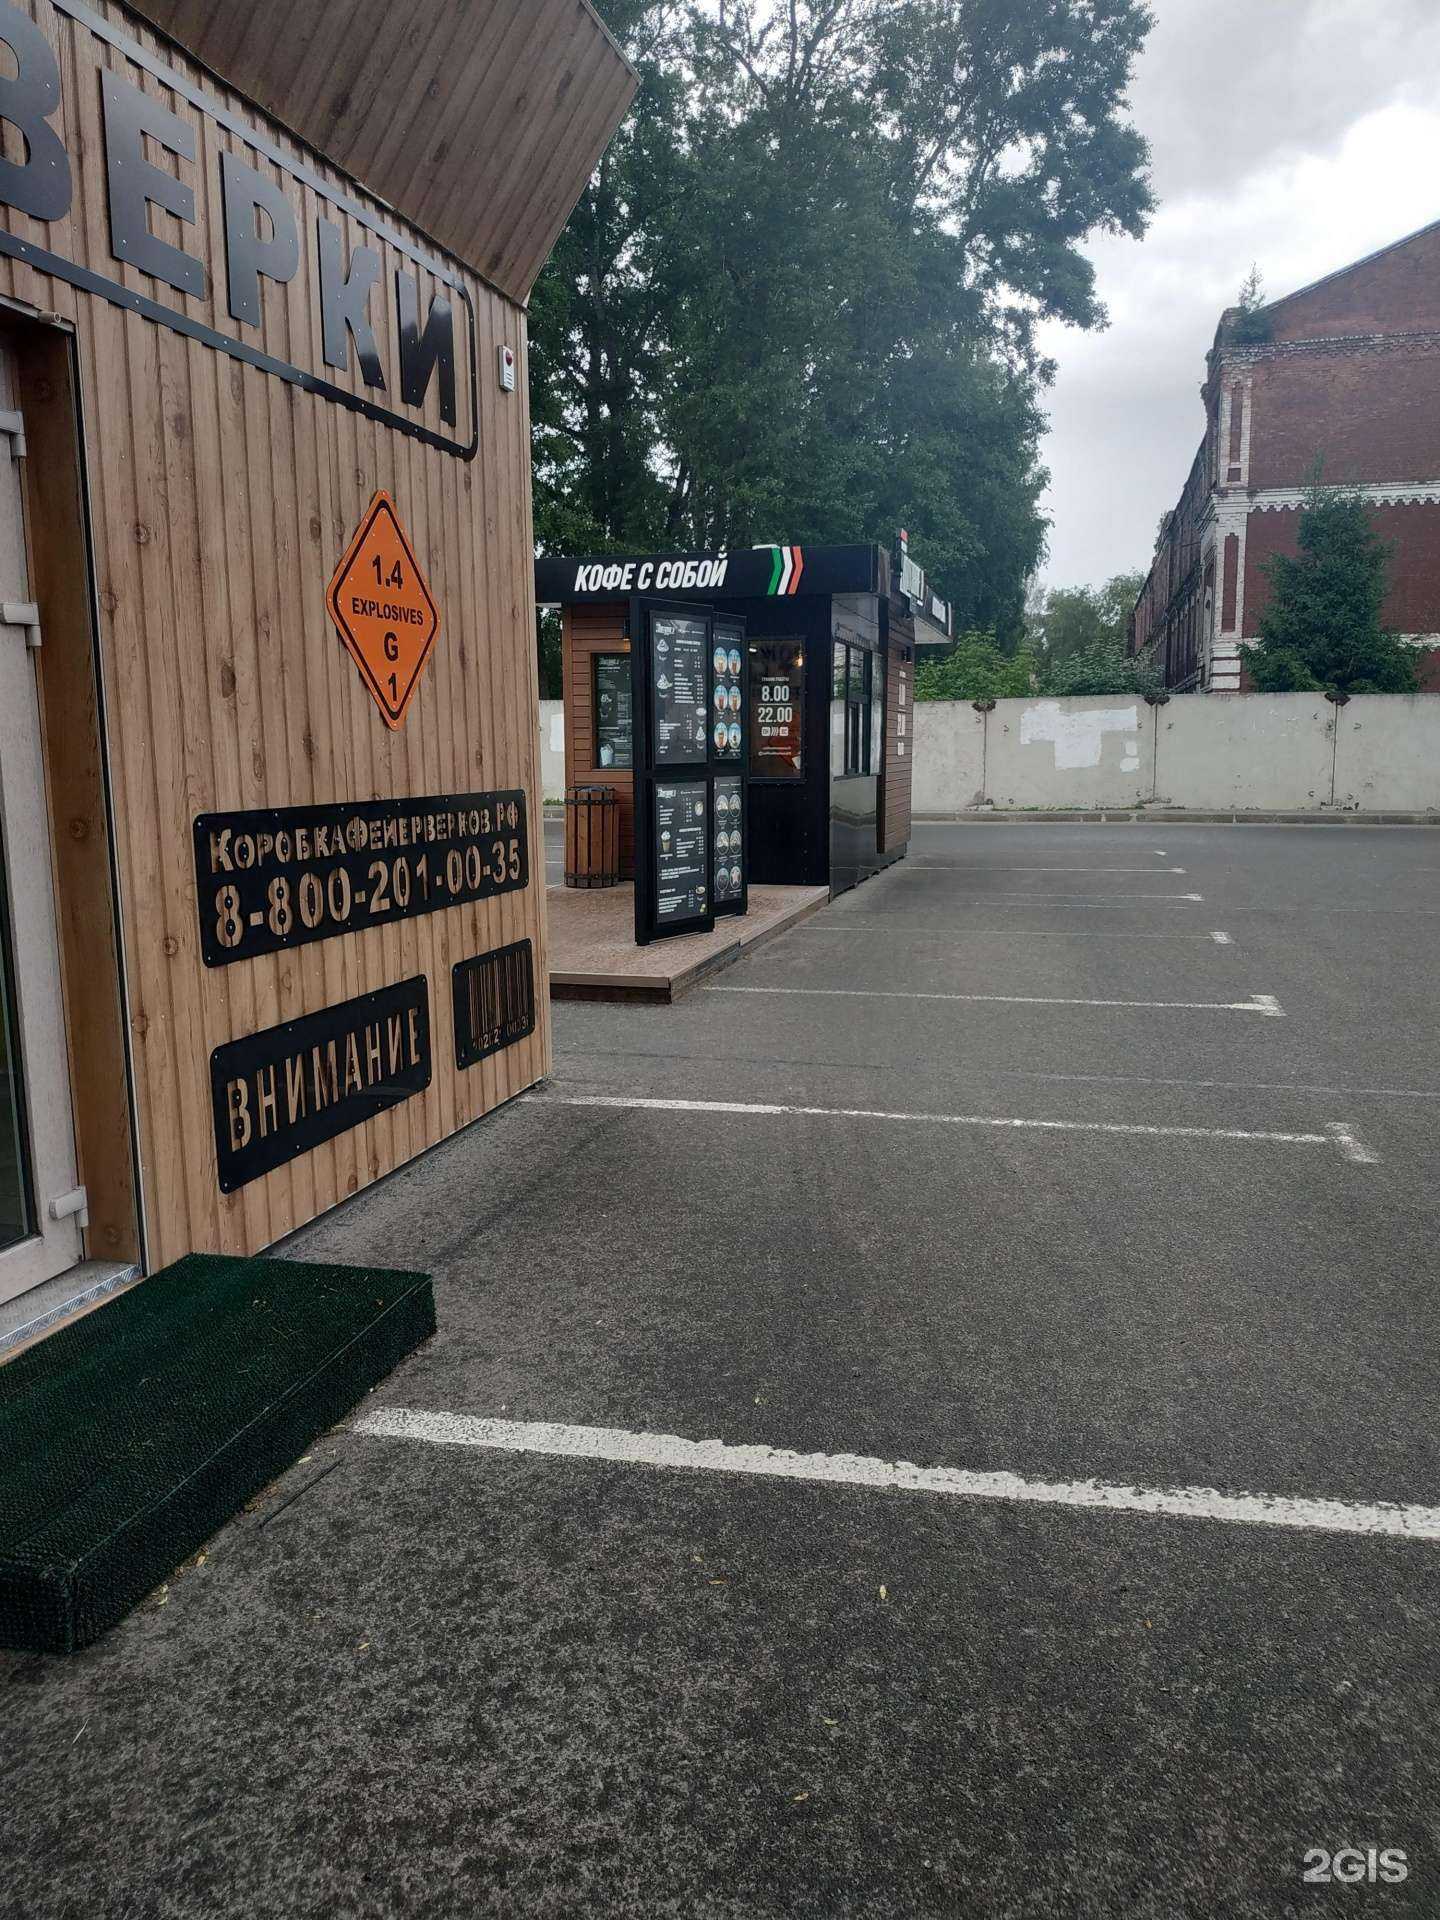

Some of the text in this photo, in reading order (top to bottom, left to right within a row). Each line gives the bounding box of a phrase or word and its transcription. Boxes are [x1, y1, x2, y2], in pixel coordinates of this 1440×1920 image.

[372, 554, 404, 590] 1.4
[574, 549, 729, 592] КОФЕ С СОБОЙ
[351, 596, 424, 627] EXPLOSIVES
[383, 631, 400, 662] G
[388, 672, 398, 702] 1
[761, 685, 790, 702] 8.00
[758, 706, 793, 723] 22.00
[215, 839, 521, 948] 8-800-201-00-35
[227, 1007, 421, 1153] ВНИМАНИЕ
